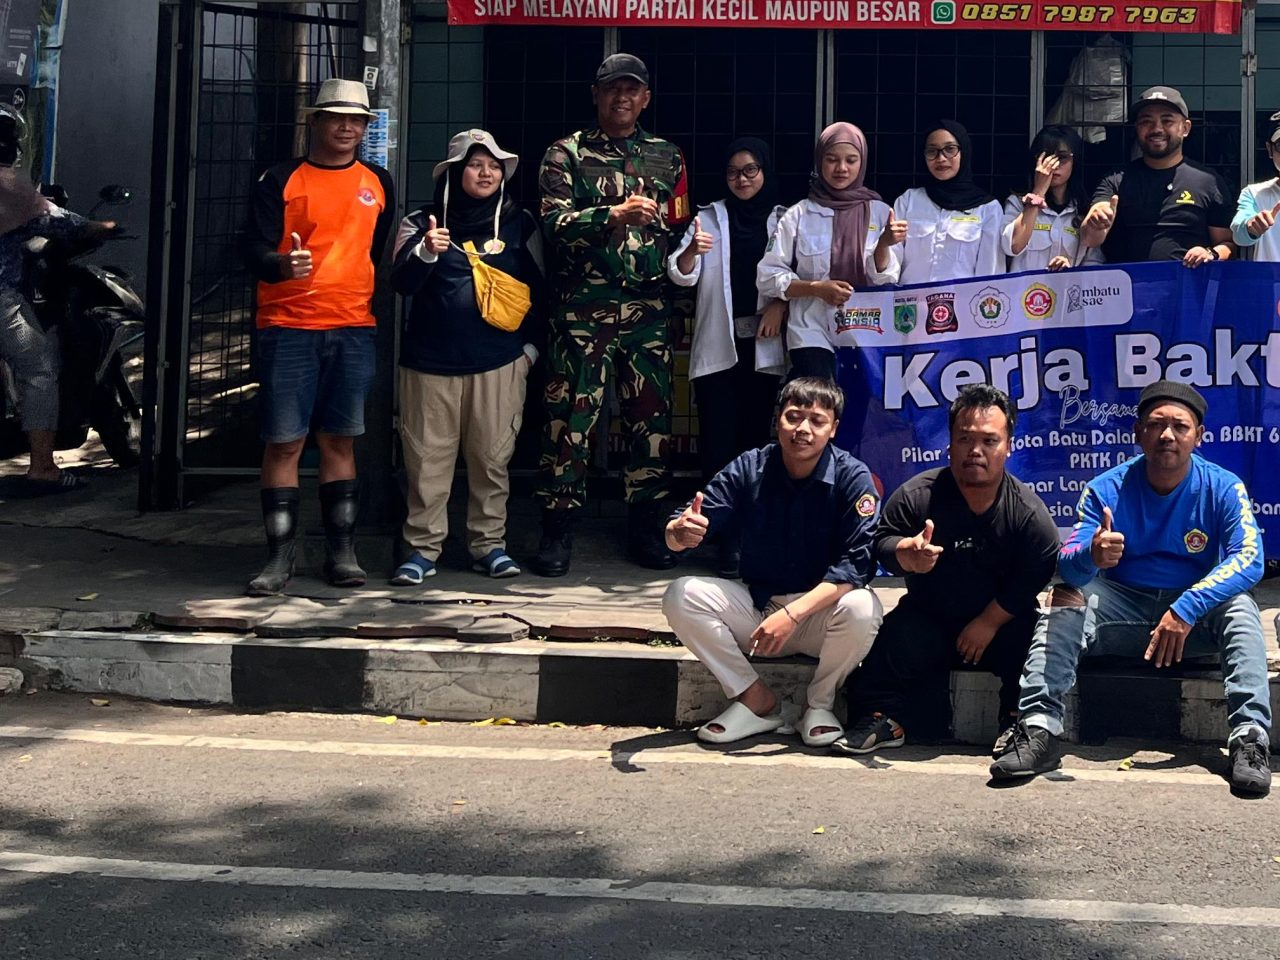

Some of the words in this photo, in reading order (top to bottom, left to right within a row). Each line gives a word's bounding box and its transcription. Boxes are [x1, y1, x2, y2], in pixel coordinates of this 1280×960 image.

[702, 0, 759, 21] KECIL
[766, 0, 850, 22] MAUPUN
[856, 1, 920, 21] BESAR
[962, 4, 1031, 20] 0851
[1043, 5, 1115, 22] 7987
[1125, 7, 1197, 24] 7963
[1082, 297, 1104, 307] sae
[883, 336, 1090, 411] Kerja
[1049, 431, 1087, 447] Batu
[1220, 426, 1263, 443] BBKT
[902, 447, 941, 463] Pilar
[1070, 452, 1111, 469] PKTK
